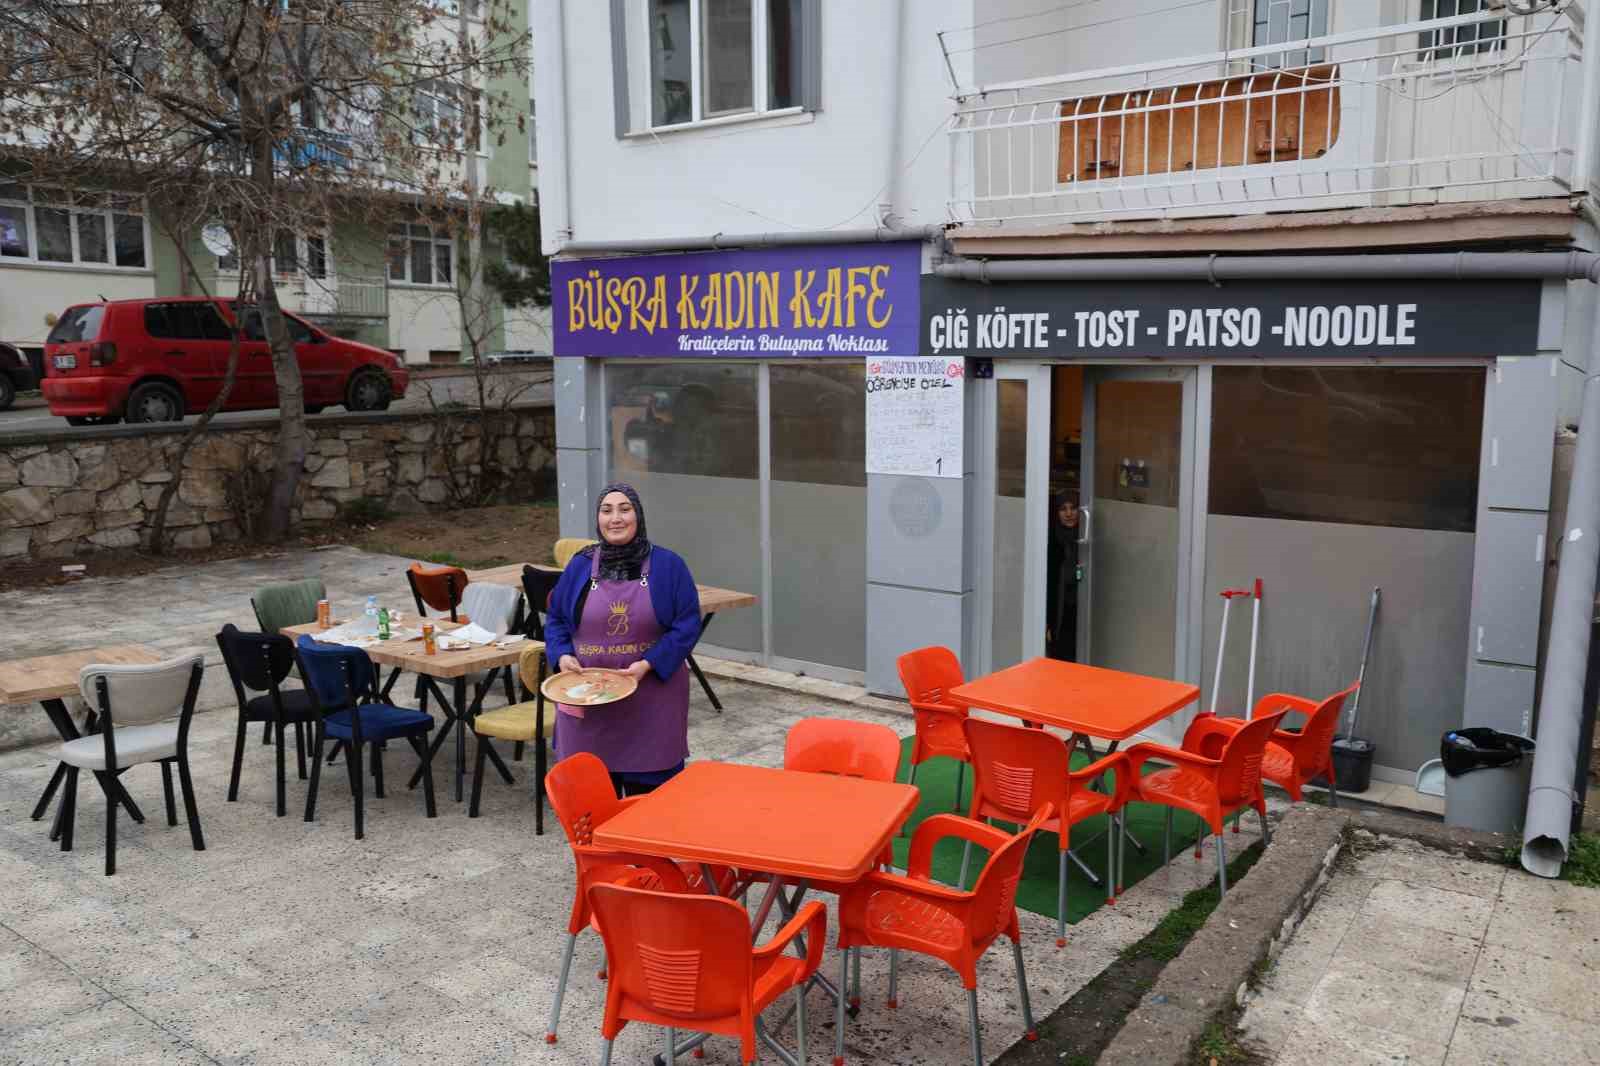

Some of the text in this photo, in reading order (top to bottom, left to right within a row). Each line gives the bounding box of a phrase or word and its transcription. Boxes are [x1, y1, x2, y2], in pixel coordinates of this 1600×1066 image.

[567, 265, 894, 335] BÜŞRA KADIN KAFE
[677, 333, 889, 356] Kraliçelerin Buluşma Noktası
[930, 308, 969, 354] ÇİĞ
[976, 306, 1049, 349] KÖFTE
[1074, 310, 1140, 347] TOST
[1167, 307, 1262, 348] PATSO
[606, 613, 630, 636] B
